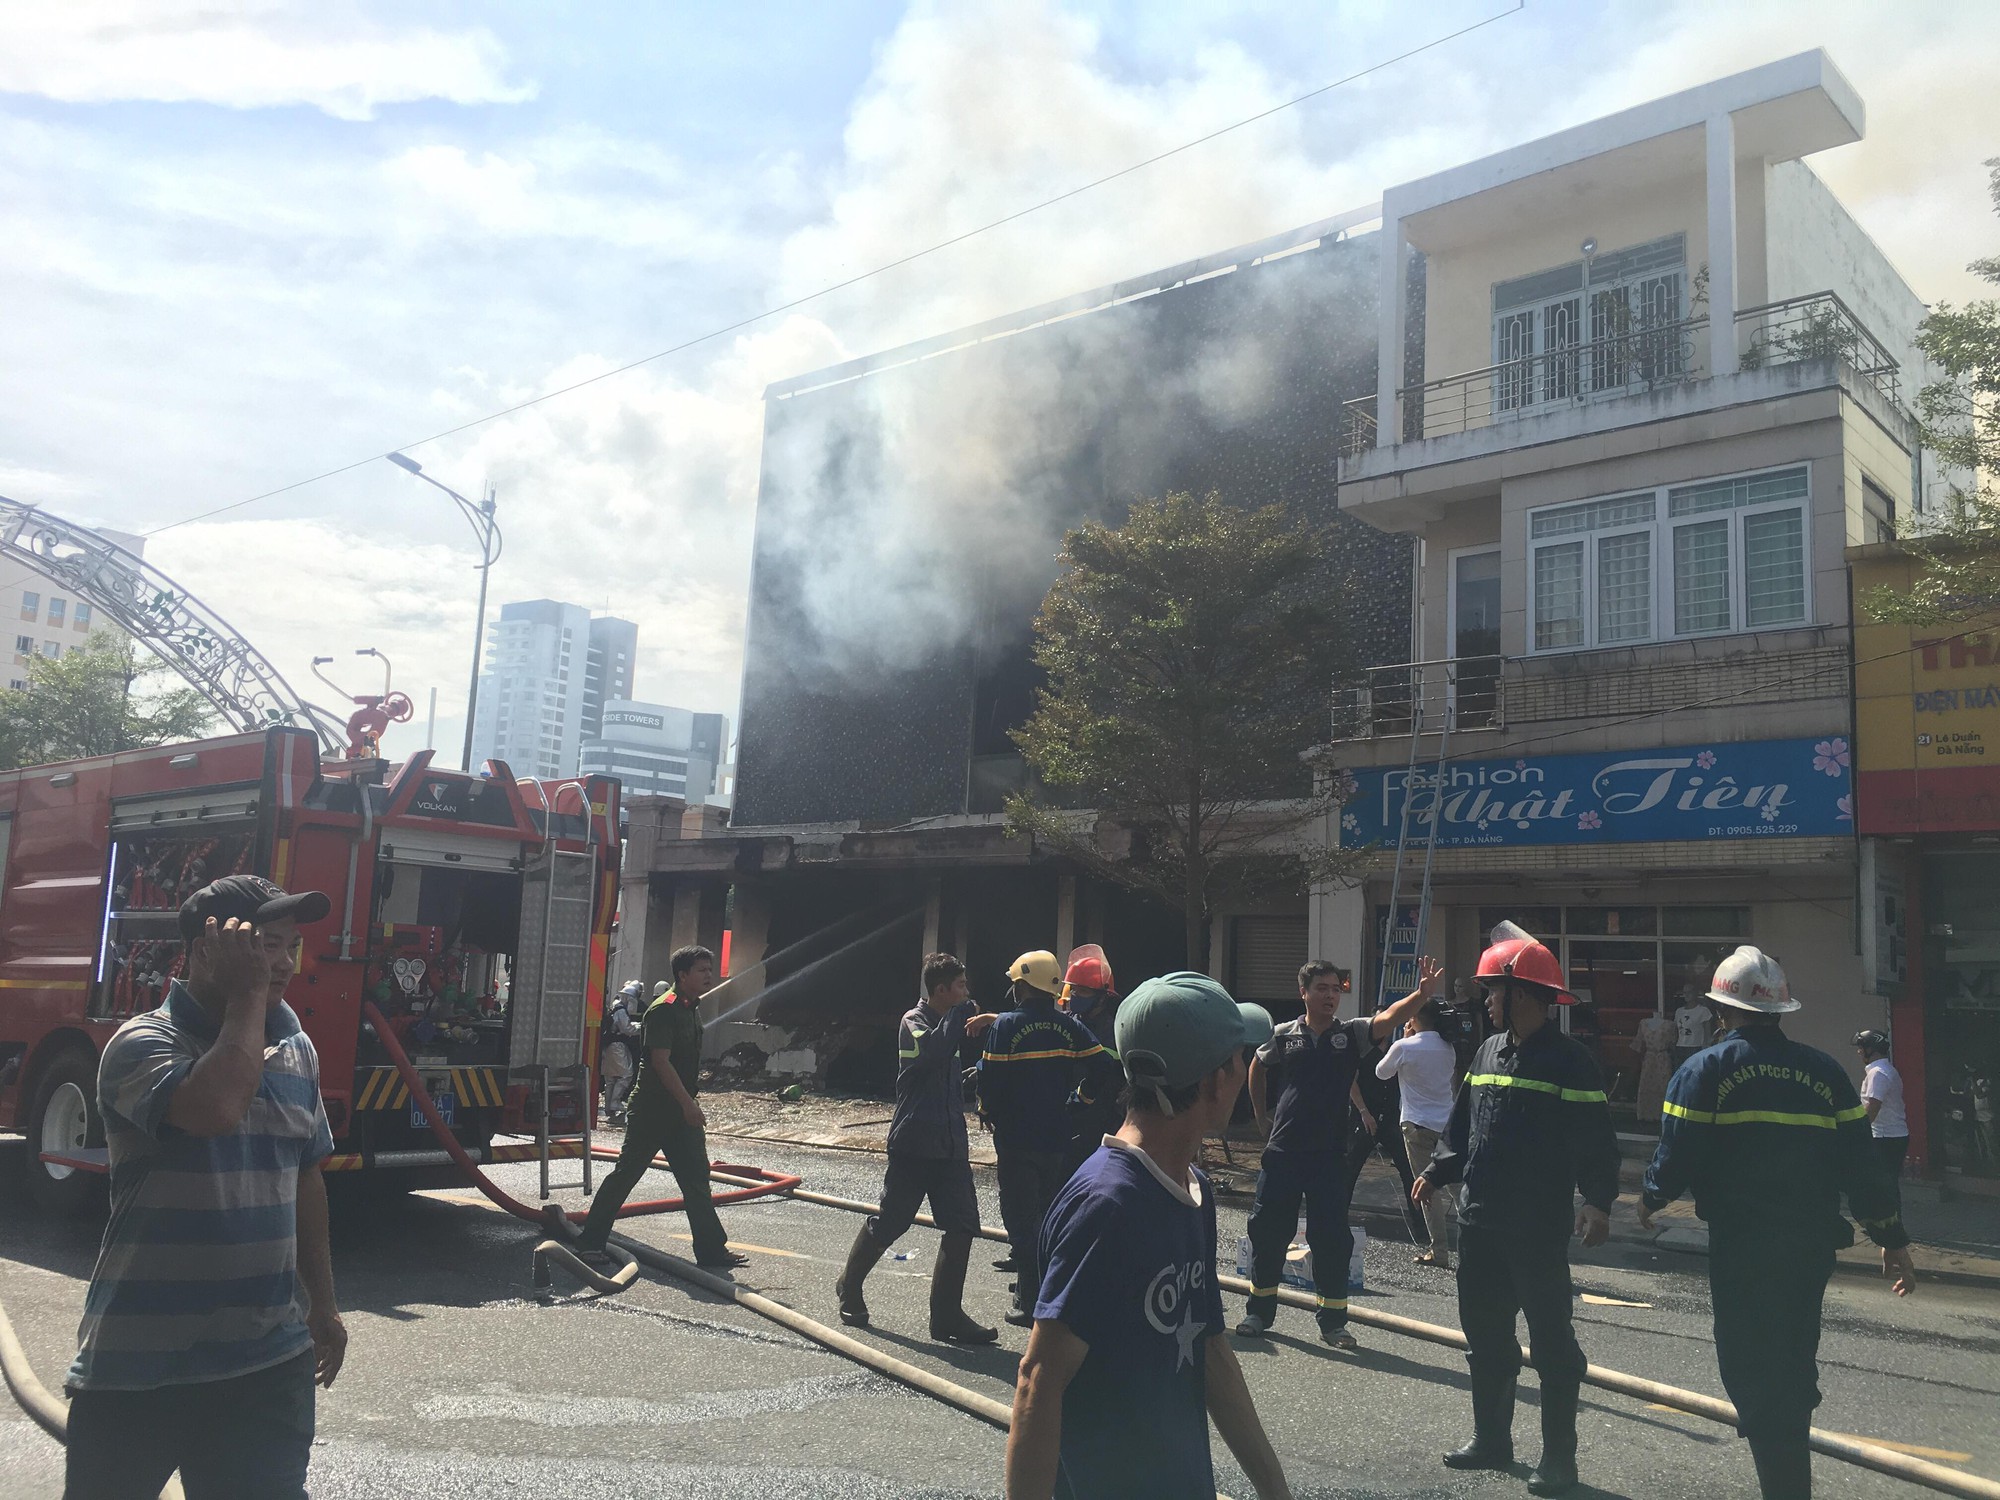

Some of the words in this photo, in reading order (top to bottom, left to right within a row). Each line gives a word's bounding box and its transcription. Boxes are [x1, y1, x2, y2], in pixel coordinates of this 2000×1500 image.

[624, 714, 660, 726] TOWERS
[1917, 735, 1931, 745] 21
[1935, 734, 1950, 743] Lê
[1382, 766, 1545, 827] Fashion
[1400, 788, 1577, 830] Nhật
[1591, 757, 1797, 815] Tiên
[416, 801, 457, 813] VOLKAN
[1708, 827, 1724, 836] ĐT:
[1727, 824, 1798, 836] 0905.525.229
[1732, 1064, 1757, 1085] SÁT
[1758, 1064, 1791, 1080] PCCC
